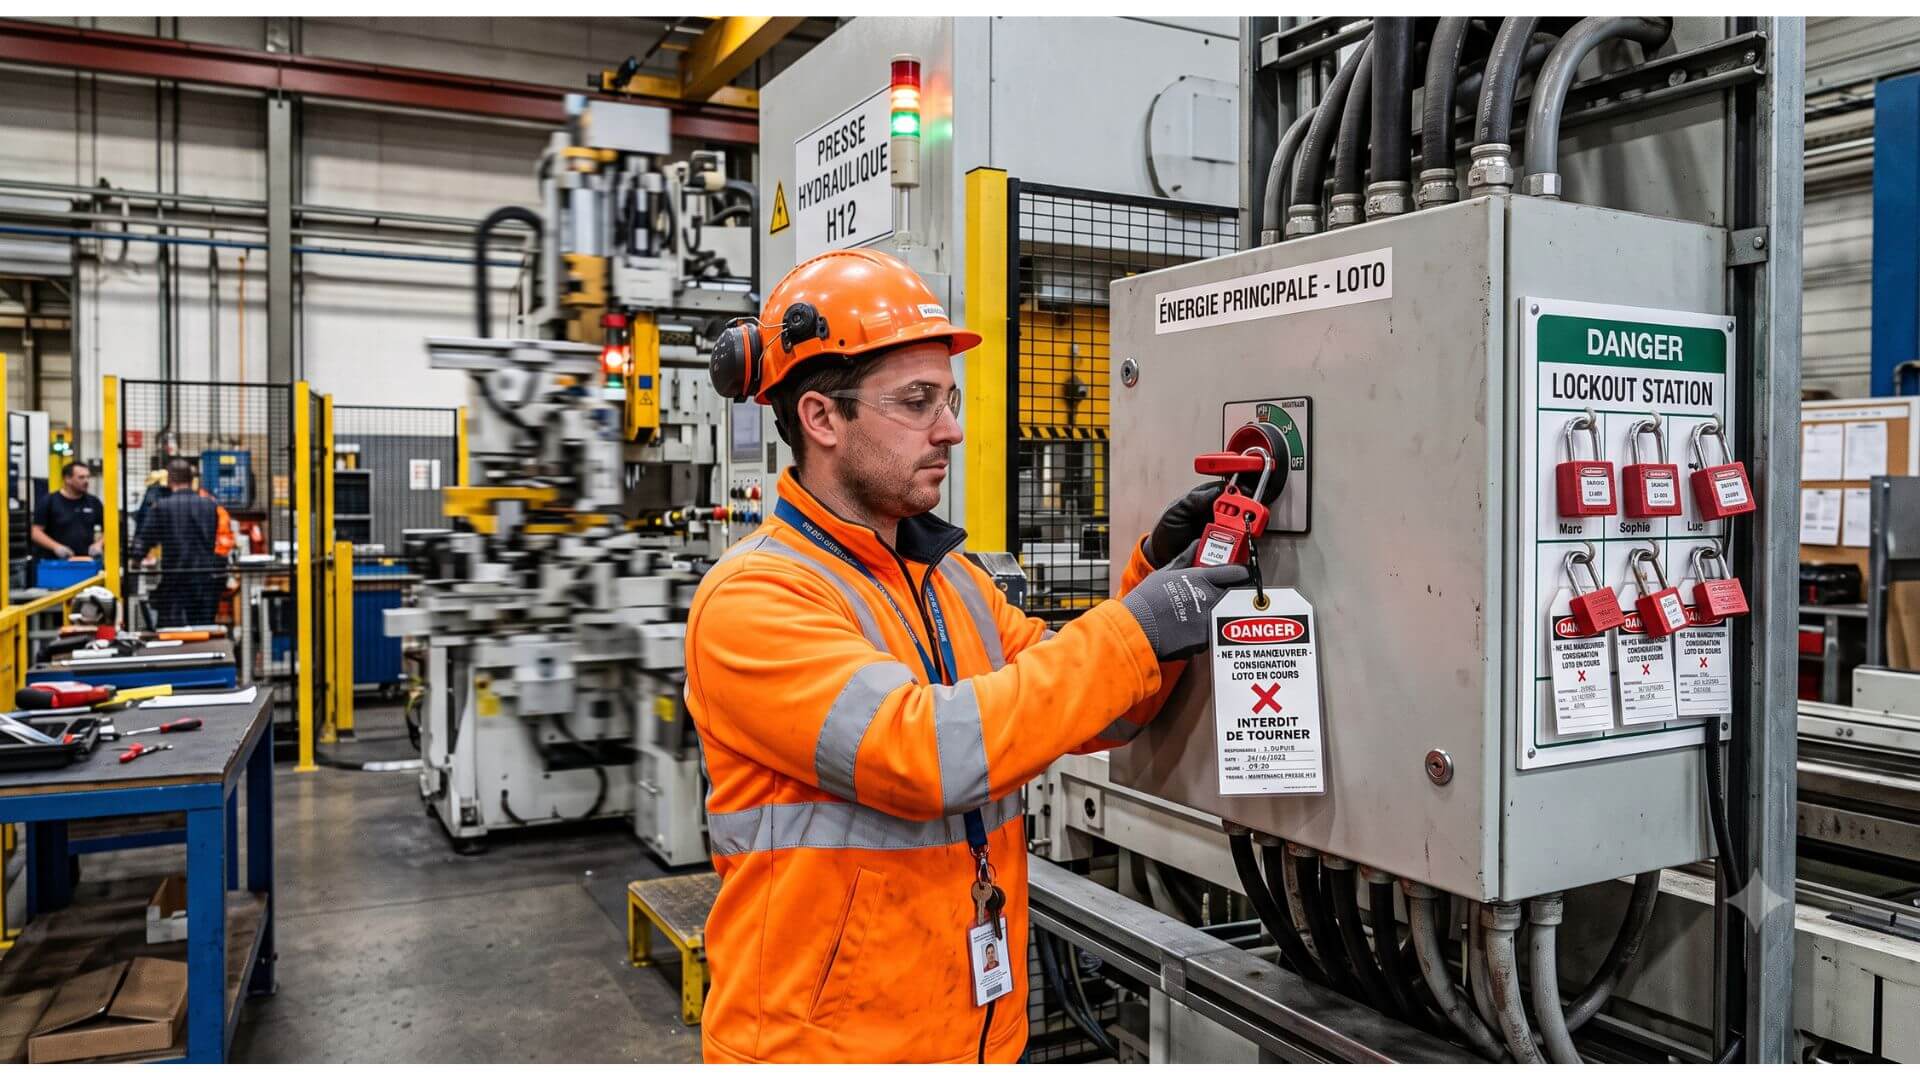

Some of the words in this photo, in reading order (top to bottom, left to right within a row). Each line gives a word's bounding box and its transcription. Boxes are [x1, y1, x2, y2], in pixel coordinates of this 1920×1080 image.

[818, 114, 866, 166] PRESSE
[798, 142, 888, 211] HYDRAULIQUE
[827, 200, 856, 243] H12
[1160, 293, 1219, 324] ÉNERGIE
[1223, 274, 1318, 313] PRINCIPALE
[1336, 262, 1386, 294] LOTO
[1587, 328, 1683, 362] DANGER
[1552, 372, 1637, 402] LOCKOUT
[1642, 378, 1712, 406] STATION
[1292, 456, 1304, 468] OFF
[1560, 523, 1582, 534] Marc
[1620, 521, 1650, 535] Sophie
[1688, 522, 1703, 532] Luc
[1230, 624, 1295, 638] DANGER
[1222, 650, 1233, 658] NE
[1235, 650, 1250, 658] PAS
[1253, 648, 1308, 658] MANŒUVRER
[1234, 660, 1296, 670] CONSIGNATION
[1232, 672, 1254, 680] LOTO
[1256, 672, 1268, 680] EN
[1270, 670, 1299, 679] COURS
[1238, 716, 1299, 728] INTERDIT
[1226, 731, 1244, 740] DE
[1247, 729, 1310, 740] TOURNER
